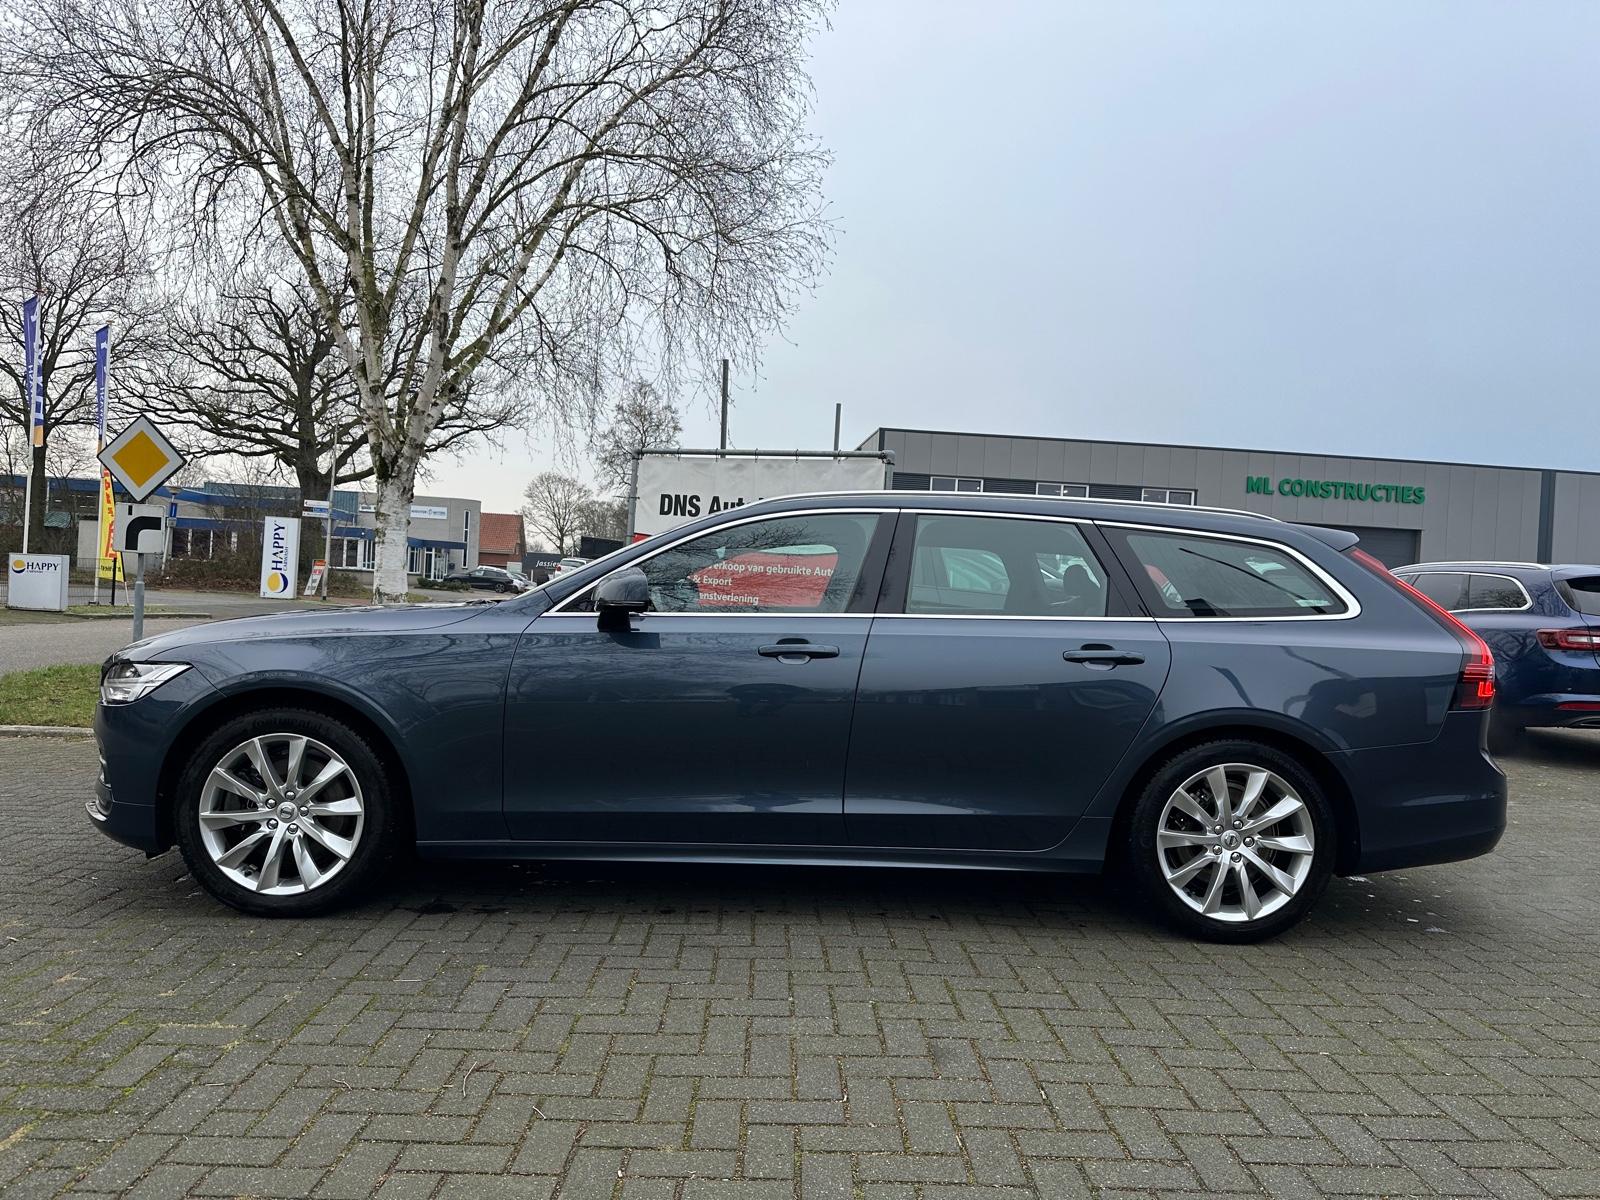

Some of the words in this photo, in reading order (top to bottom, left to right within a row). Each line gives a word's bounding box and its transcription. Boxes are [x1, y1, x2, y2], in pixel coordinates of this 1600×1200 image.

[1246, 476, 1274, 495] ML
[1279, 478, 1426, 504] CONSTRUCTIES
[659, 494, 701, 517] DNS
[708, 496, 751, 514] Aut
[271, 522, 285, 571] HAPPY
[26, 561, 59, 571] HAPPY
[747, 564, 764, 573] van
[766, 564, 812, 575] gebruikte
[692, 574, 701, 584] &
[703, 575, 733, 587] Export
